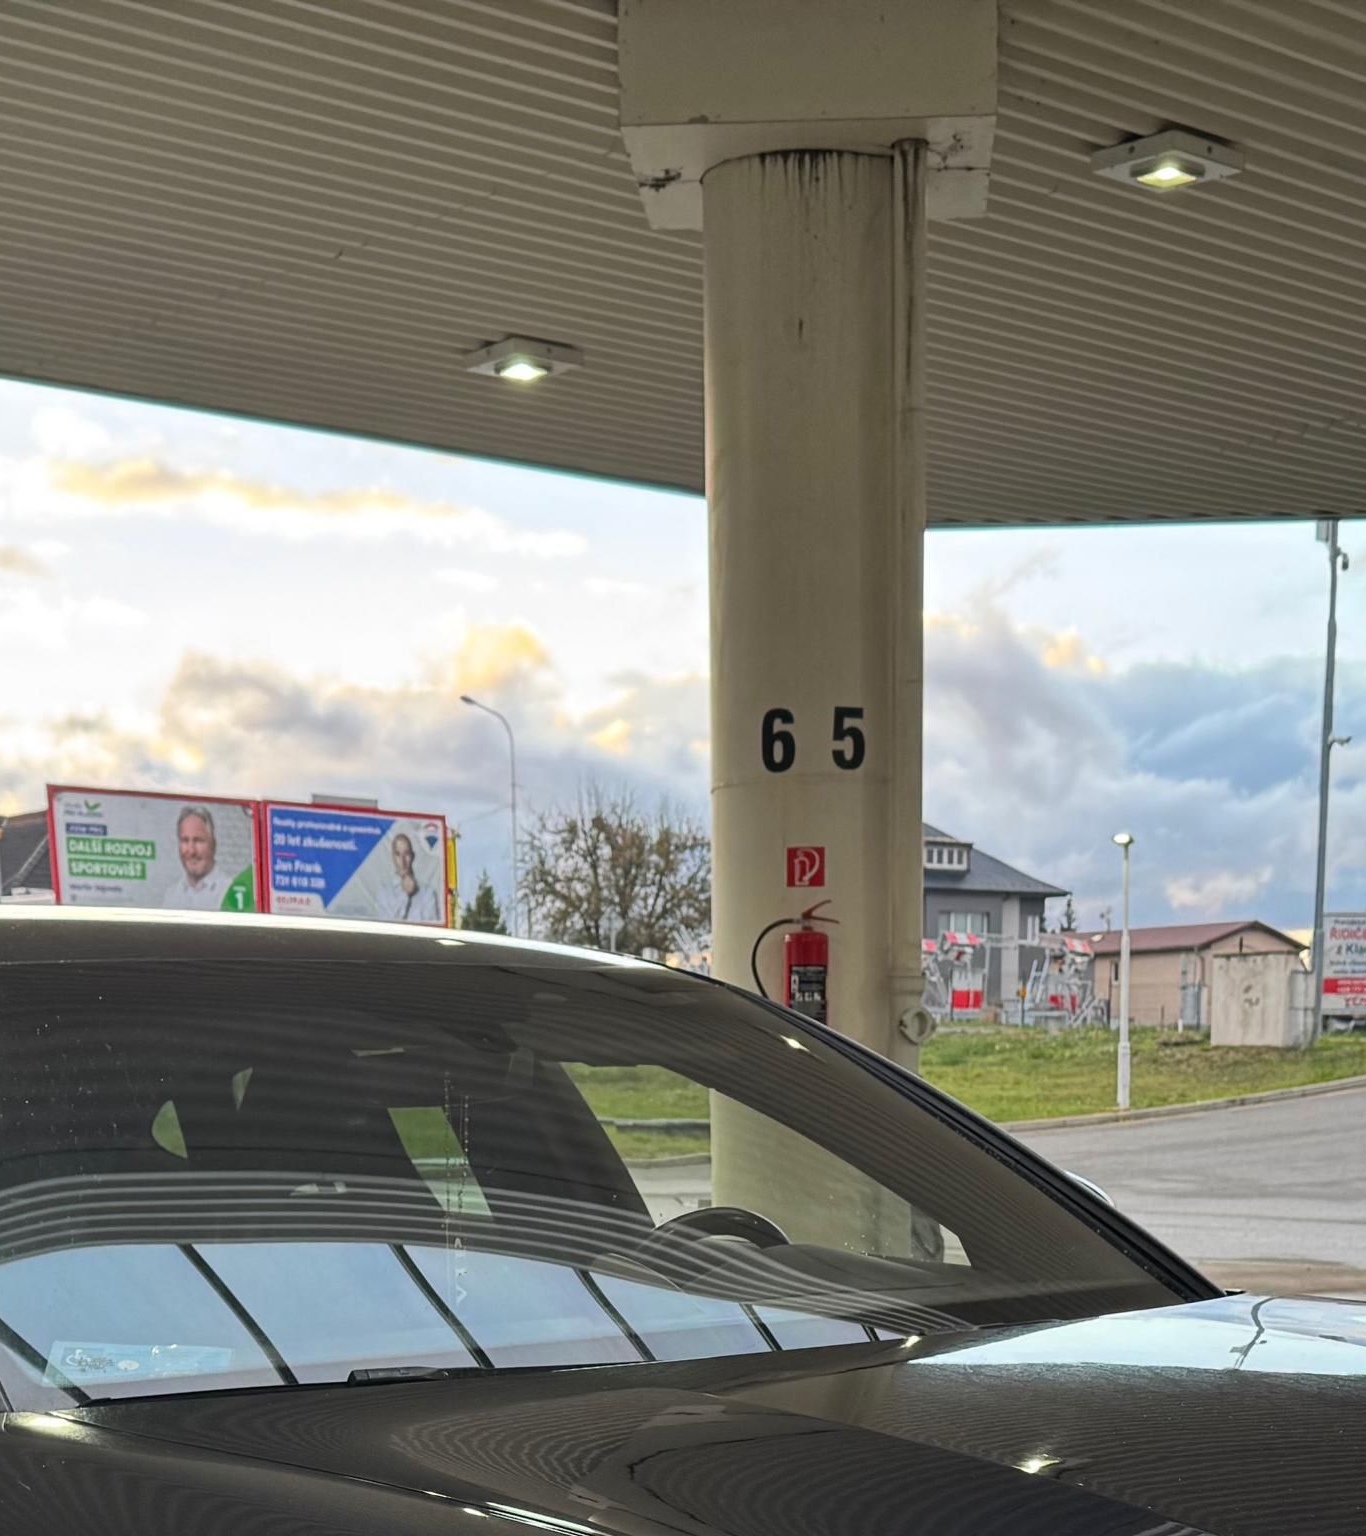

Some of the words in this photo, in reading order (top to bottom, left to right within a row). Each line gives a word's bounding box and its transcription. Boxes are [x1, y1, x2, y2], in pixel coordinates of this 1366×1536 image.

[761, 708, 796, 773] 6
[831, 706, 866, 771] 5
[69, 838, 103, 853] DALŠÍ
[104, 842, 152, 857] ROZVOJ
